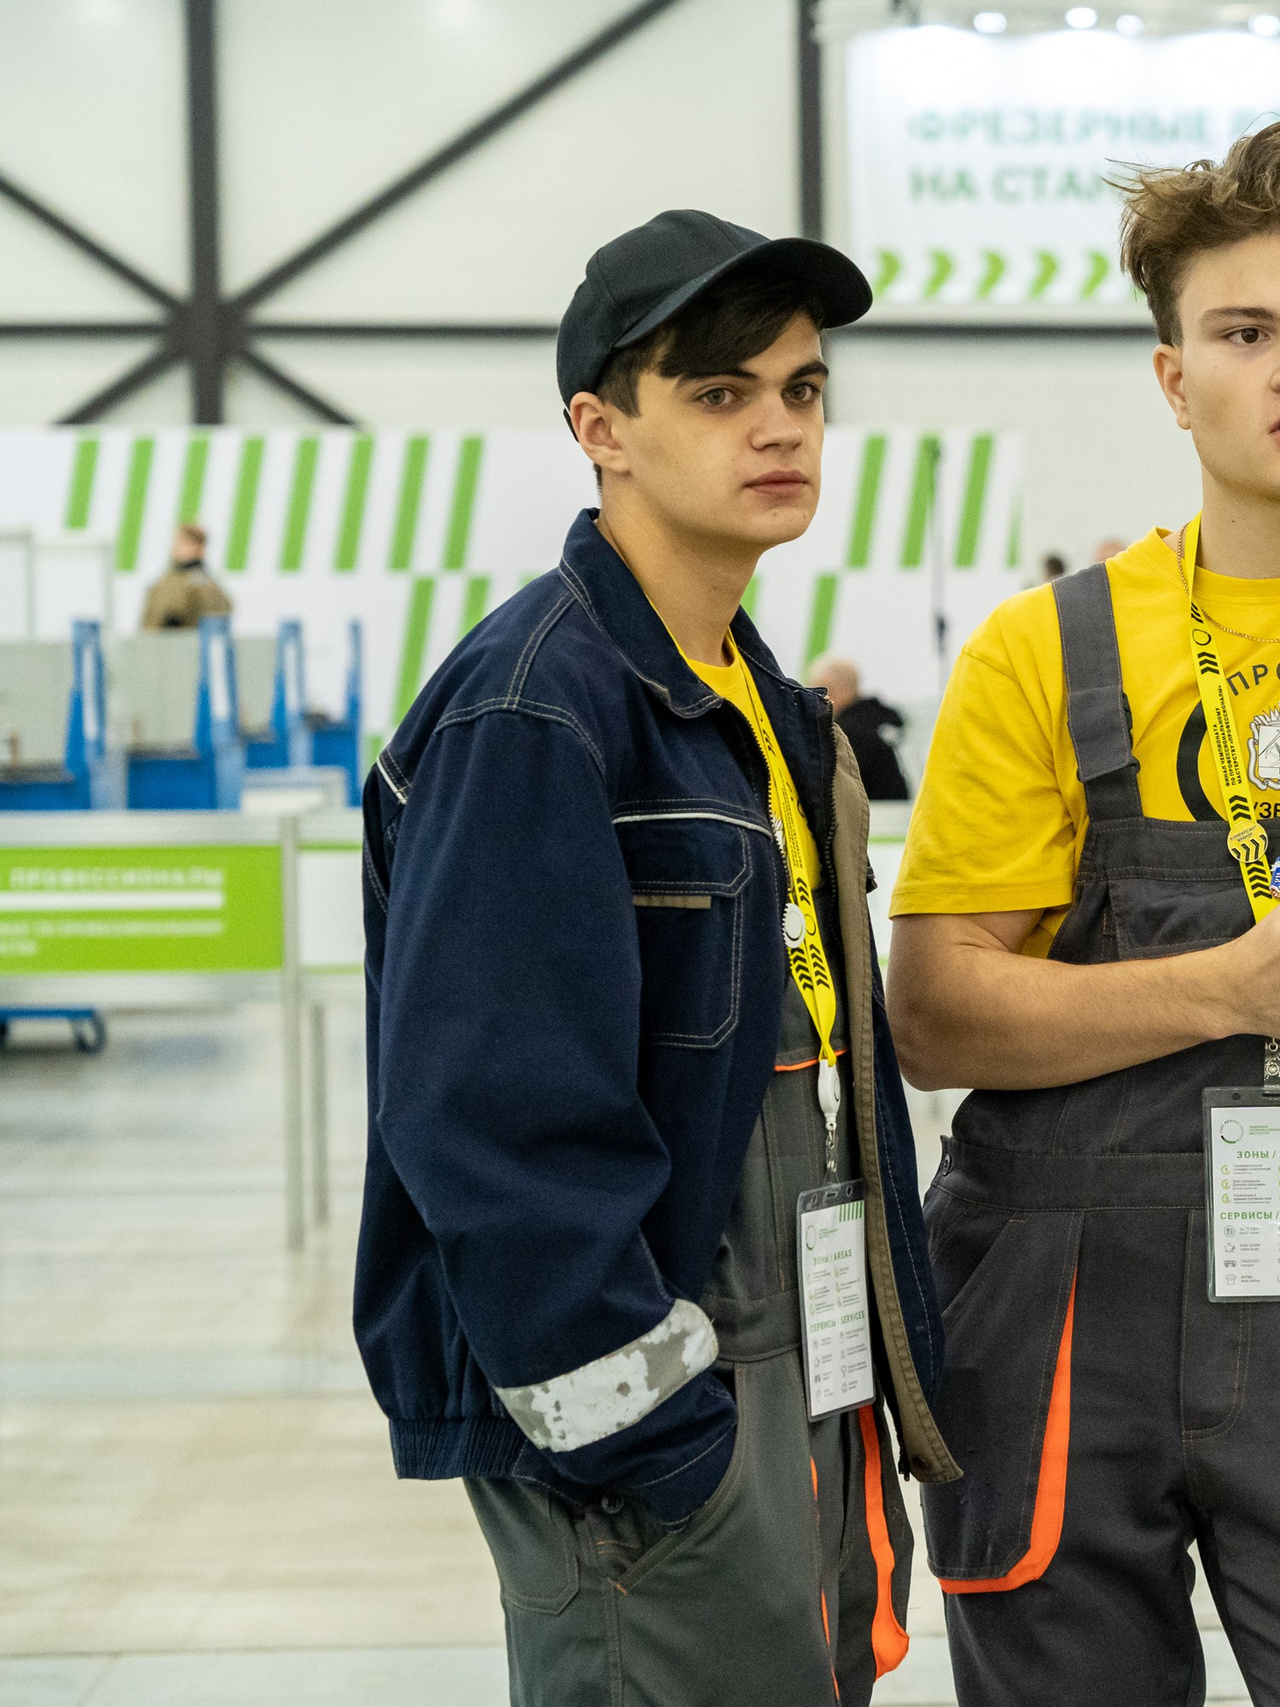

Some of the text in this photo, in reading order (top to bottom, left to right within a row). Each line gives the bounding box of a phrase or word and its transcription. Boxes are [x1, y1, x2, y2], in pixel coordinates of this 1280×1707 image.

[907, 109, 1206, 144] ФРЕЗЕРНЫЕ
[911, 167, 977, 202] НА
[1213, 724, 1230, 787] ФИНАЛ ЧЕМПИОНАТА
[1230, 745, 1242, 784] МАСТЕРСТВУ
[1236, 1151, 1269, 1159] ЗОНЫ
[1220, 1211, 1272, 1220] СЕРВИСЫ
[833, 1249, 852, 1260] AREAS
[840, 1310, 865, 1325] SERVICES
